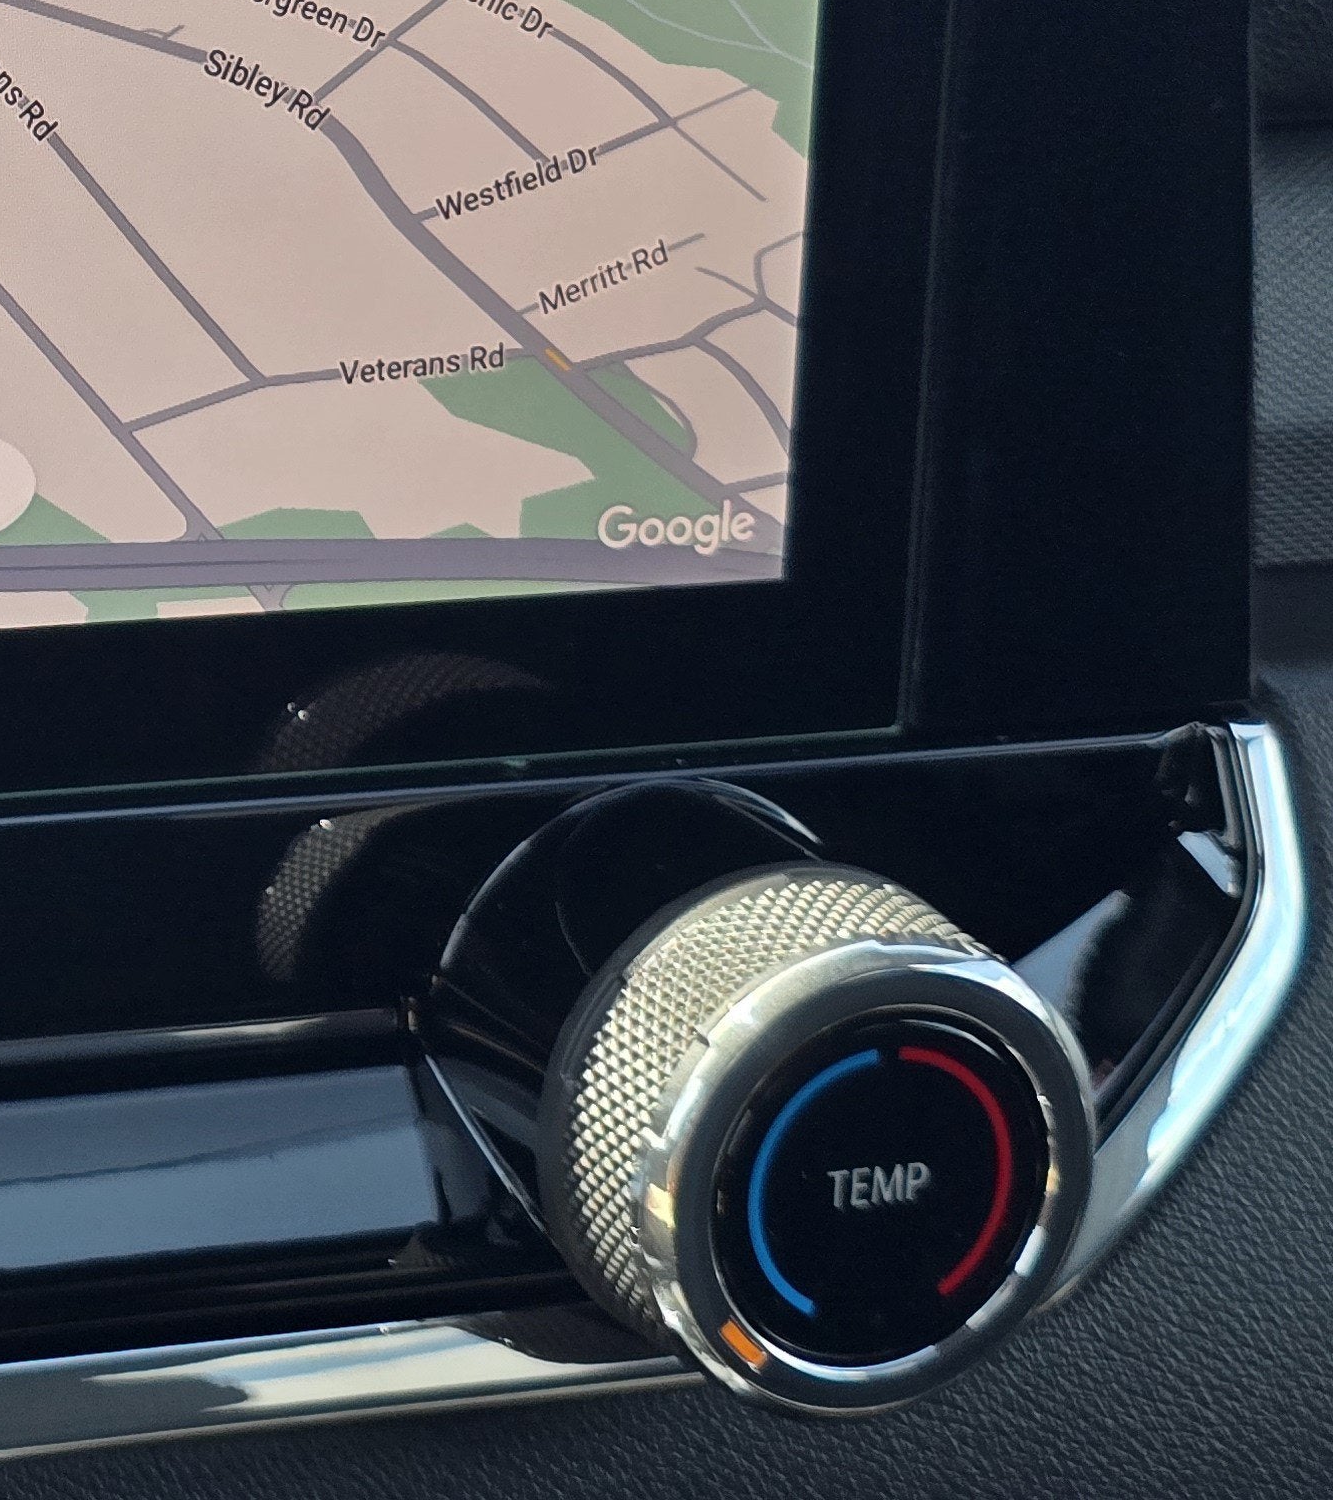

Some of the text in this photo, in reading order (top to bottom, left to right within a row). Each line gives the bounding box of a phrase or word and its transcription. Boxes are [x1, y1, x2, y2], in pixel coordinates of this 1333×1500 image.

[353, 16, 386, 49] Dr
[519, 6, 554, 40] Dr
[203, 49, 331, 132] Sibley Rd
[18, 99, 59, 142] Rd
[436, 143, 599, 220] Westfield Dr
[539, 239, 670, 314] Merritt Rd
[339, 343, 505, 384] Veterans Rd
[598, 500, 755, 557] Google
[828, 1161, 932, 1211] TEMP
